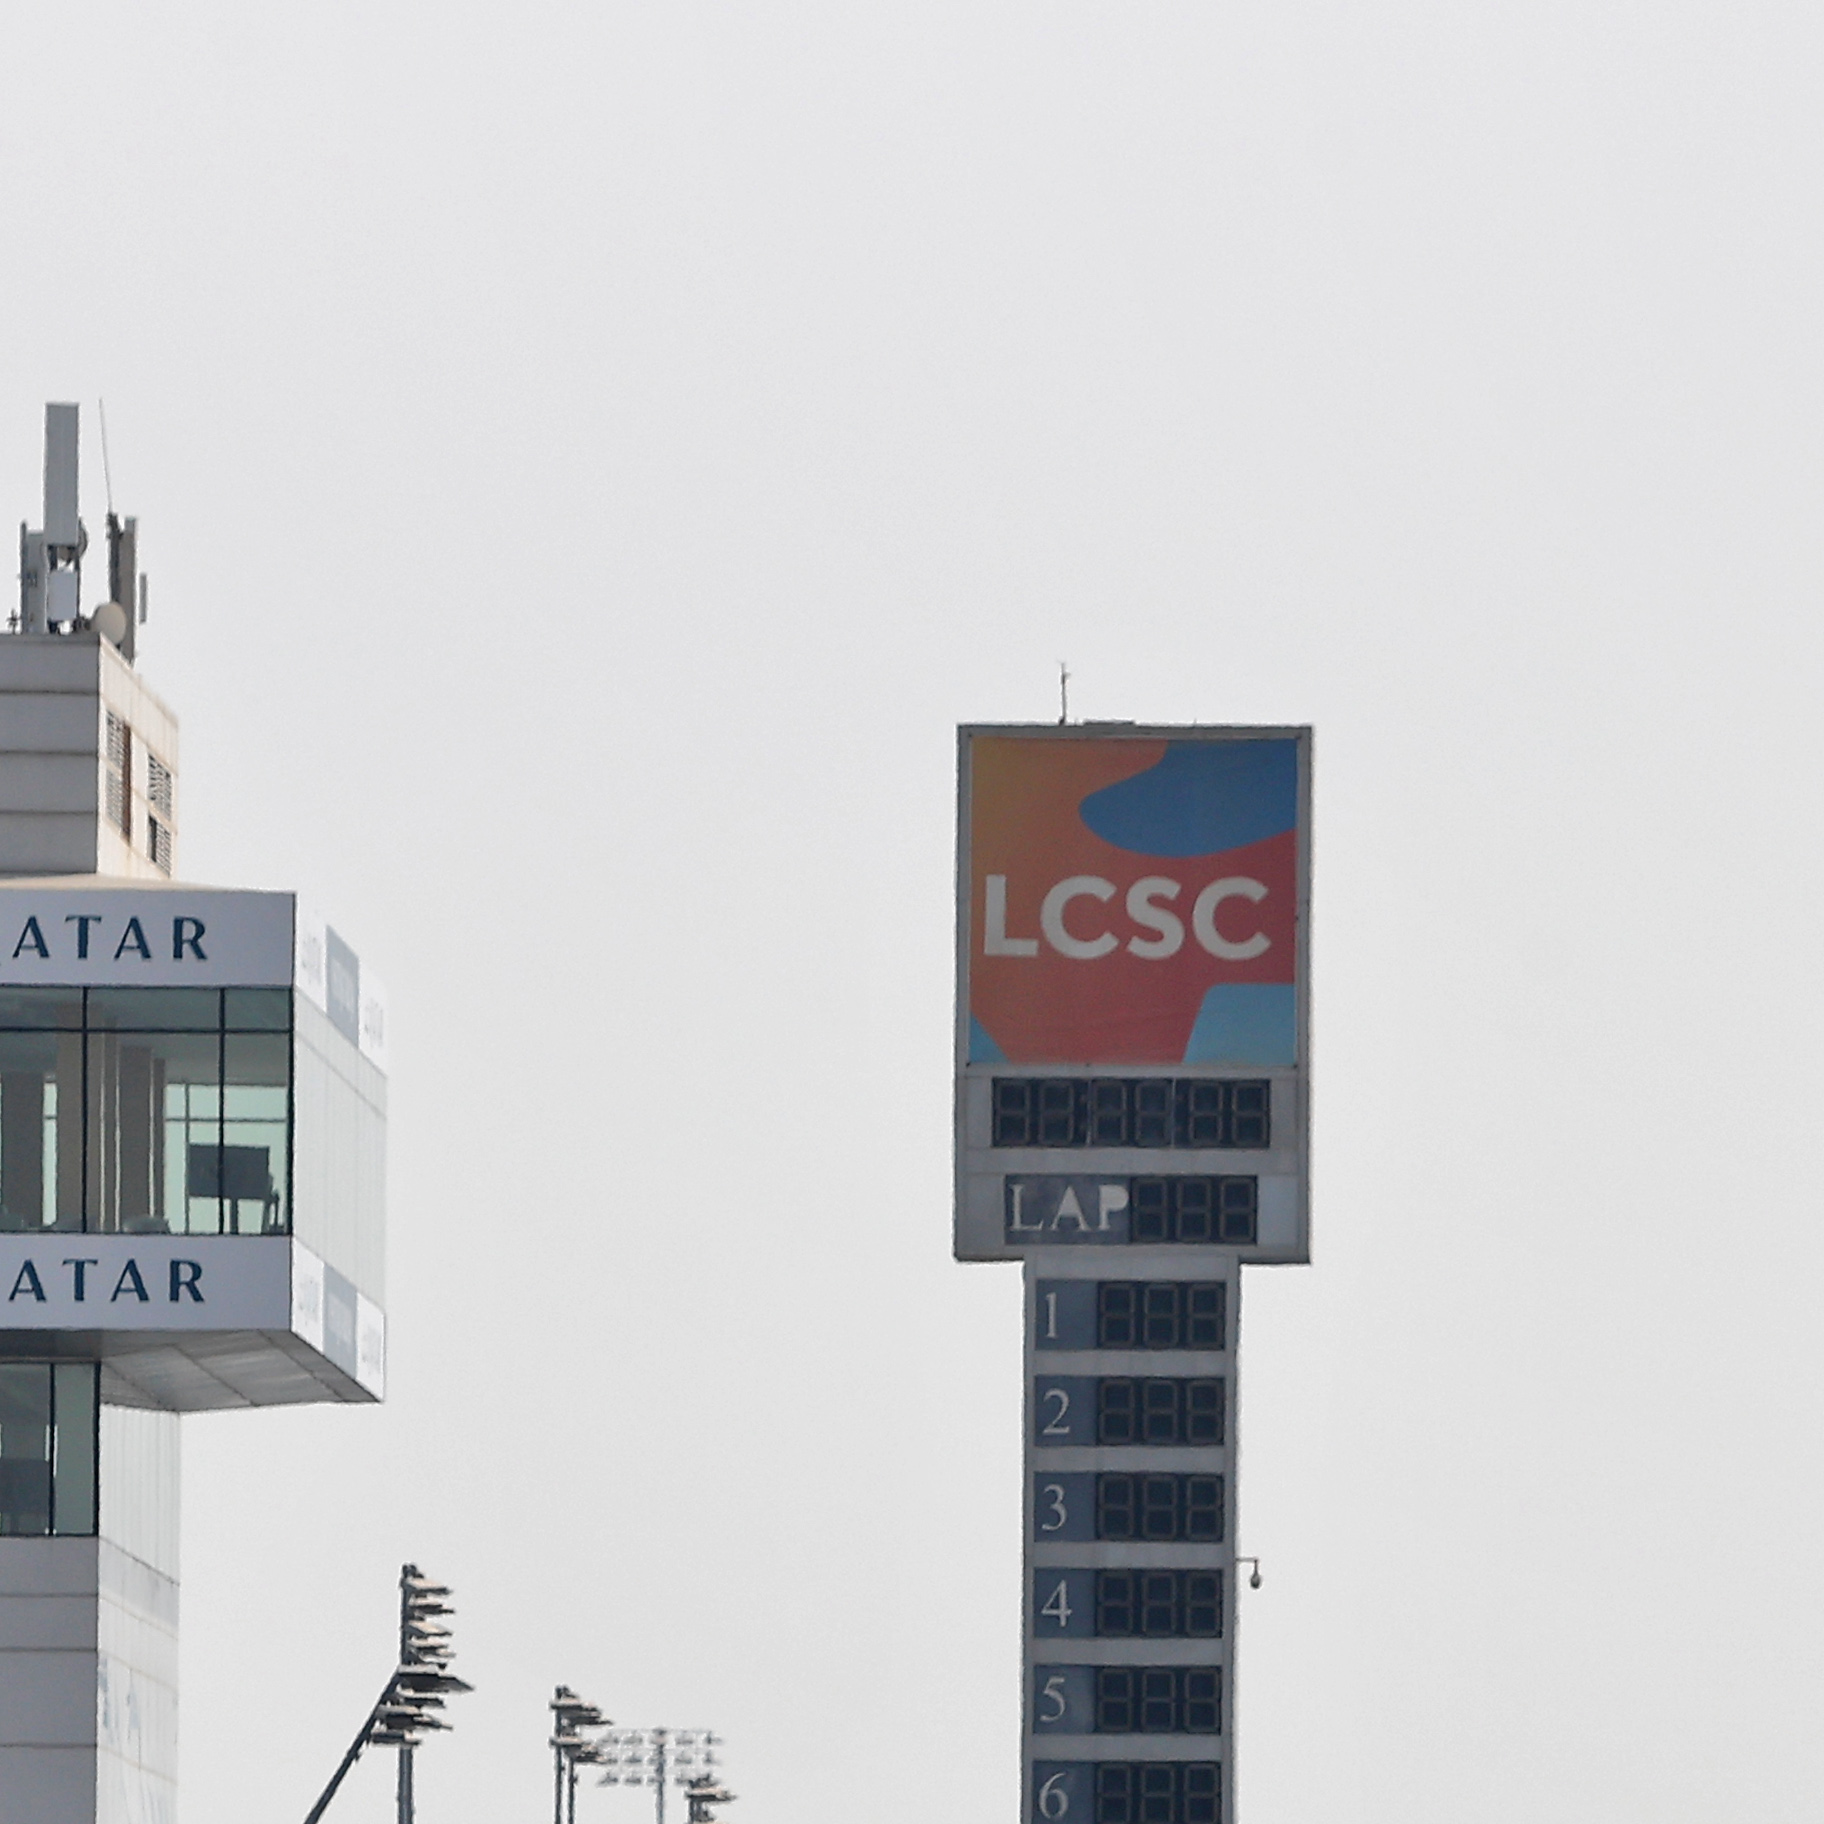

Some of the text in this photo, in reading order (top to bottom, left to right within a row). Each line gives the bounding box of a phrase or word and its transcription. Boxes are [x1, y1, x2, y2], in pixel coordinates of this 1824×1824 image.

[983, 873, 1272, 961] LCSC
[1008, 1182, 1129, 1234] LAP
[1044, 1291, 1059, 1340] 1
[1042, 1388, 1072, 1435] 2
[1041, 1483, 1068, 1532] 3
[1040, 1579, 1073, 1628] 4
[1039, 1676, 1068, 1724] 5
[1037, 1771, 1069, 1820] 6
